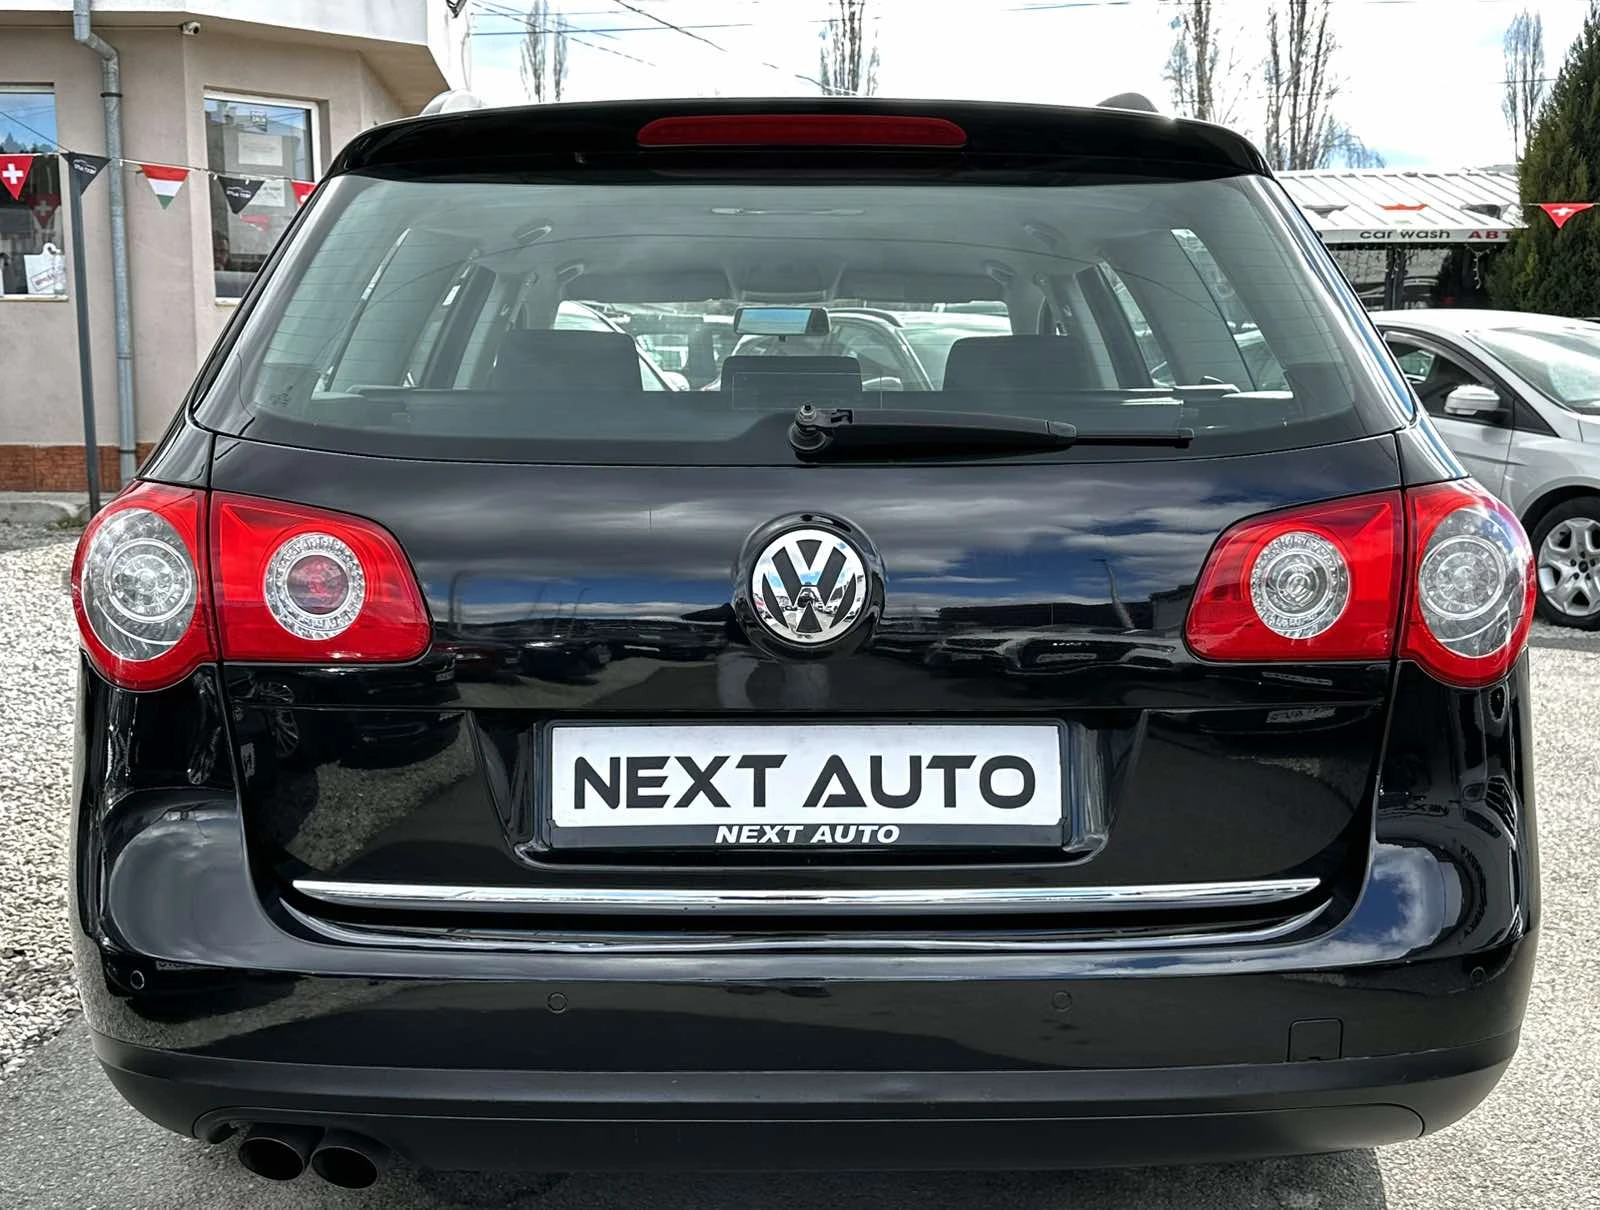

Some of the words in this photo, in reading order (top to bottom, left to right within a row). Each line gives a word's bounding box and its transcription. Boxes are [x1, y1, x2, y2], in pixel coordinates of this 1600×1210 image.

[1359, 230, 1392, 239] car
[1400, 230, 1450, 239] wash
[574, 754, 787, 809] NEXT
[802, 754, 1036, 809] AUTO
[715, 825, 804, 844] NEXT
[810, 825, 900, 844] AUTO
